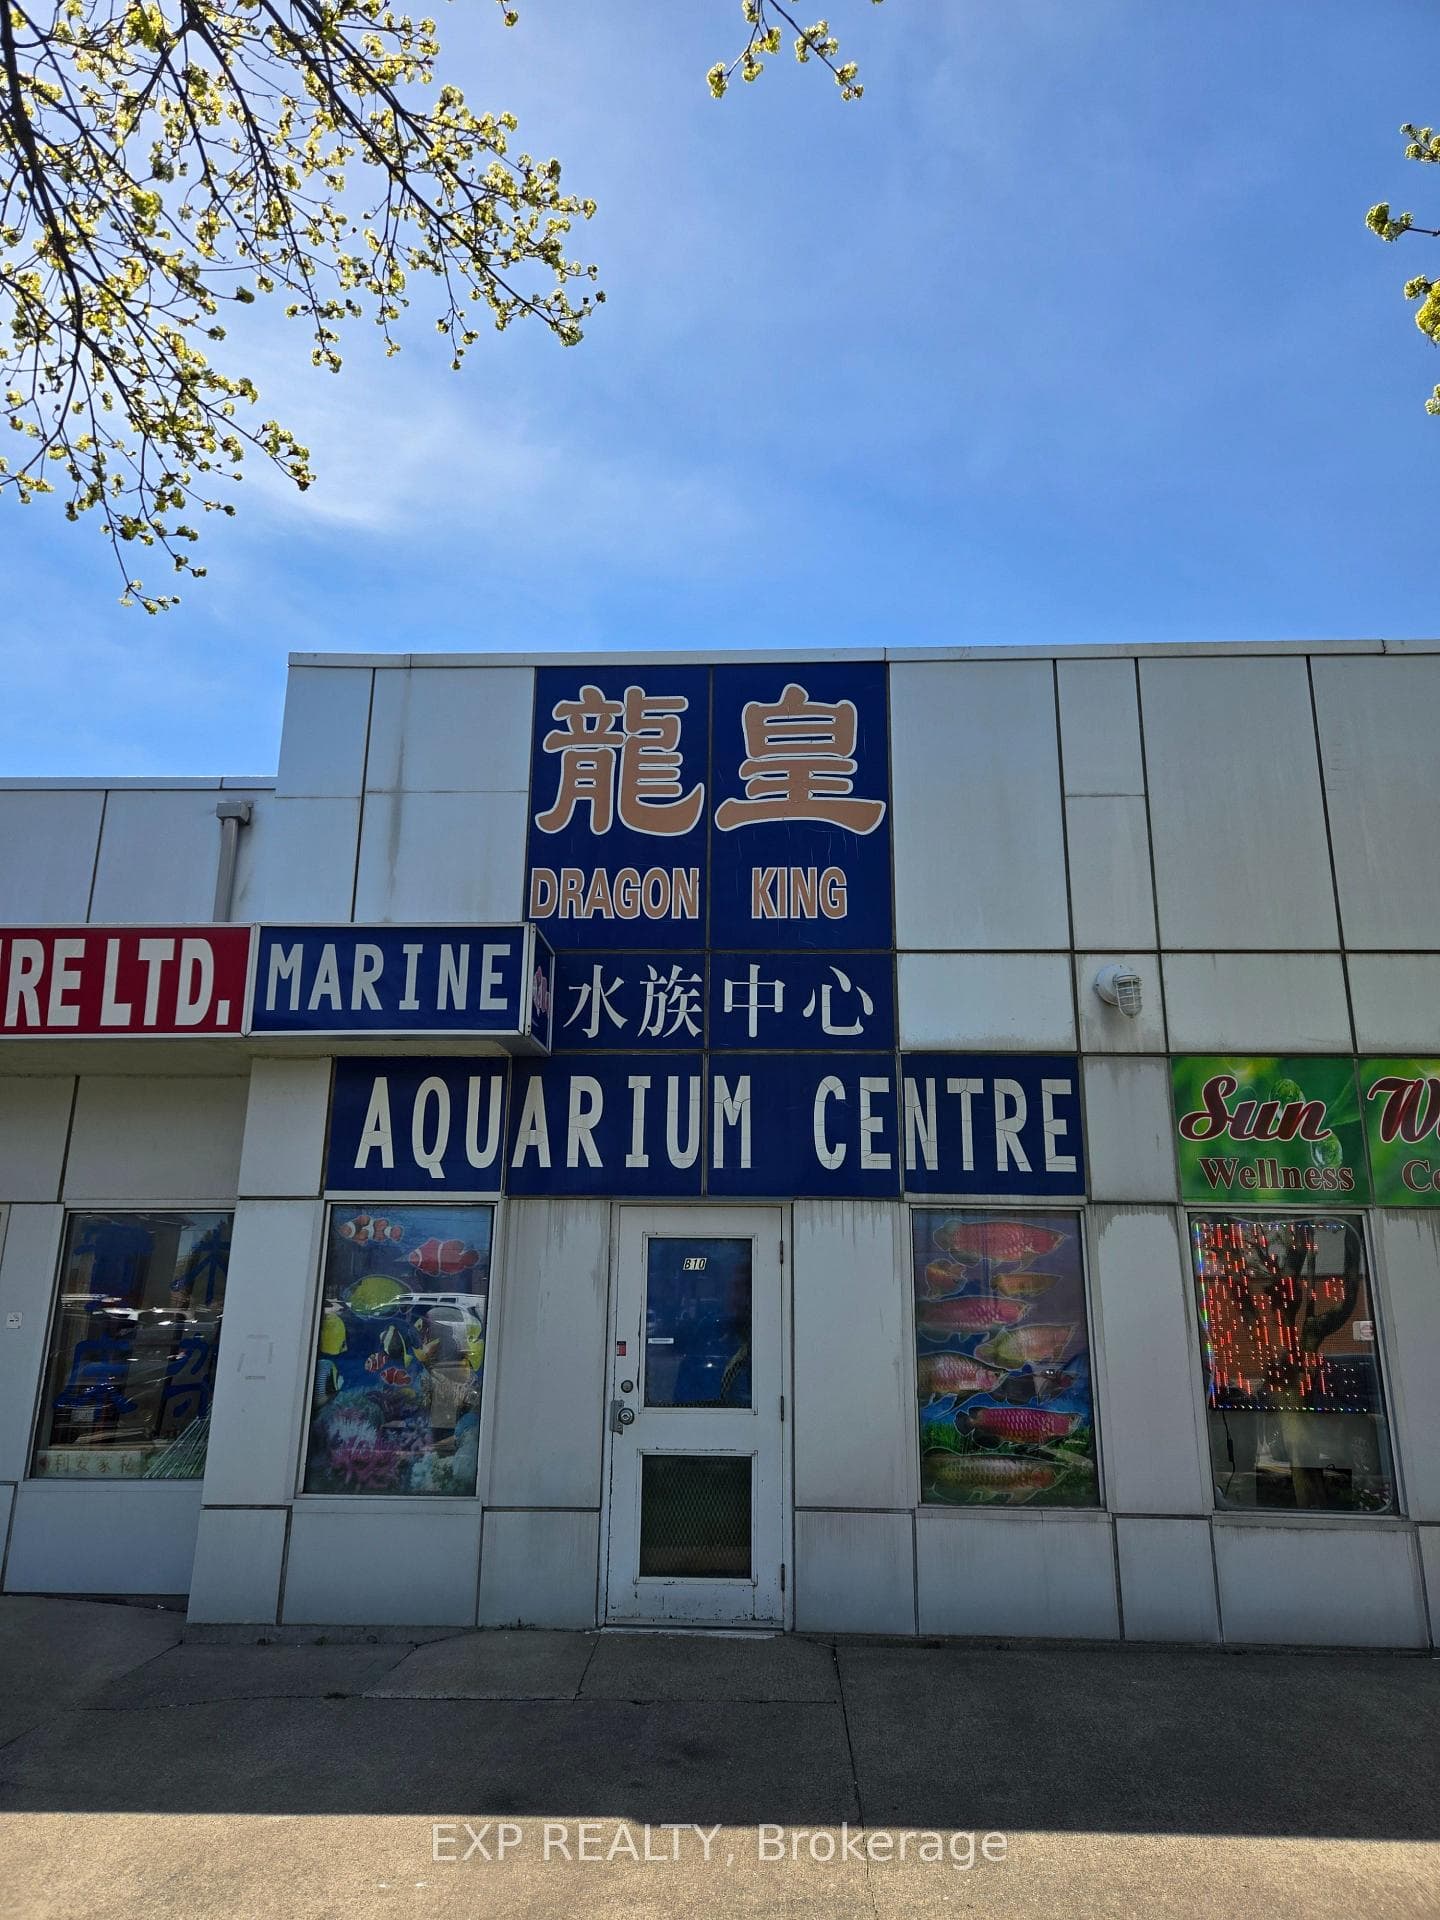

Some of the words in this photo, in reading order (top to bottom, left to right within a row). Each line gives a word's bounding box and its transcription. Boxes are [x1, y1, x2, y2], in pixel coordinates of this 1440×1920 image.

[534, 683, 886, 837] 龍皇
[529, 867, 700, 920] DRAGON
[751, 866, 848, 920] KING
[0, 938, 86, 1027] RE
[100, 938, 231, 1026] LTD.
[265, 943, 511, 1011] MARINE
[563, 964, 875, 1039] 水族中心
[354, 1075, 752, 1179] AQUARIUM
[812, 1074, 1078, 1174] CENTRE
[1179, 1075, 1334, 1142] Sun
[1366, 1076, 1440, 1144] W
[1198, 1157, 1356, 1192] Wellness
